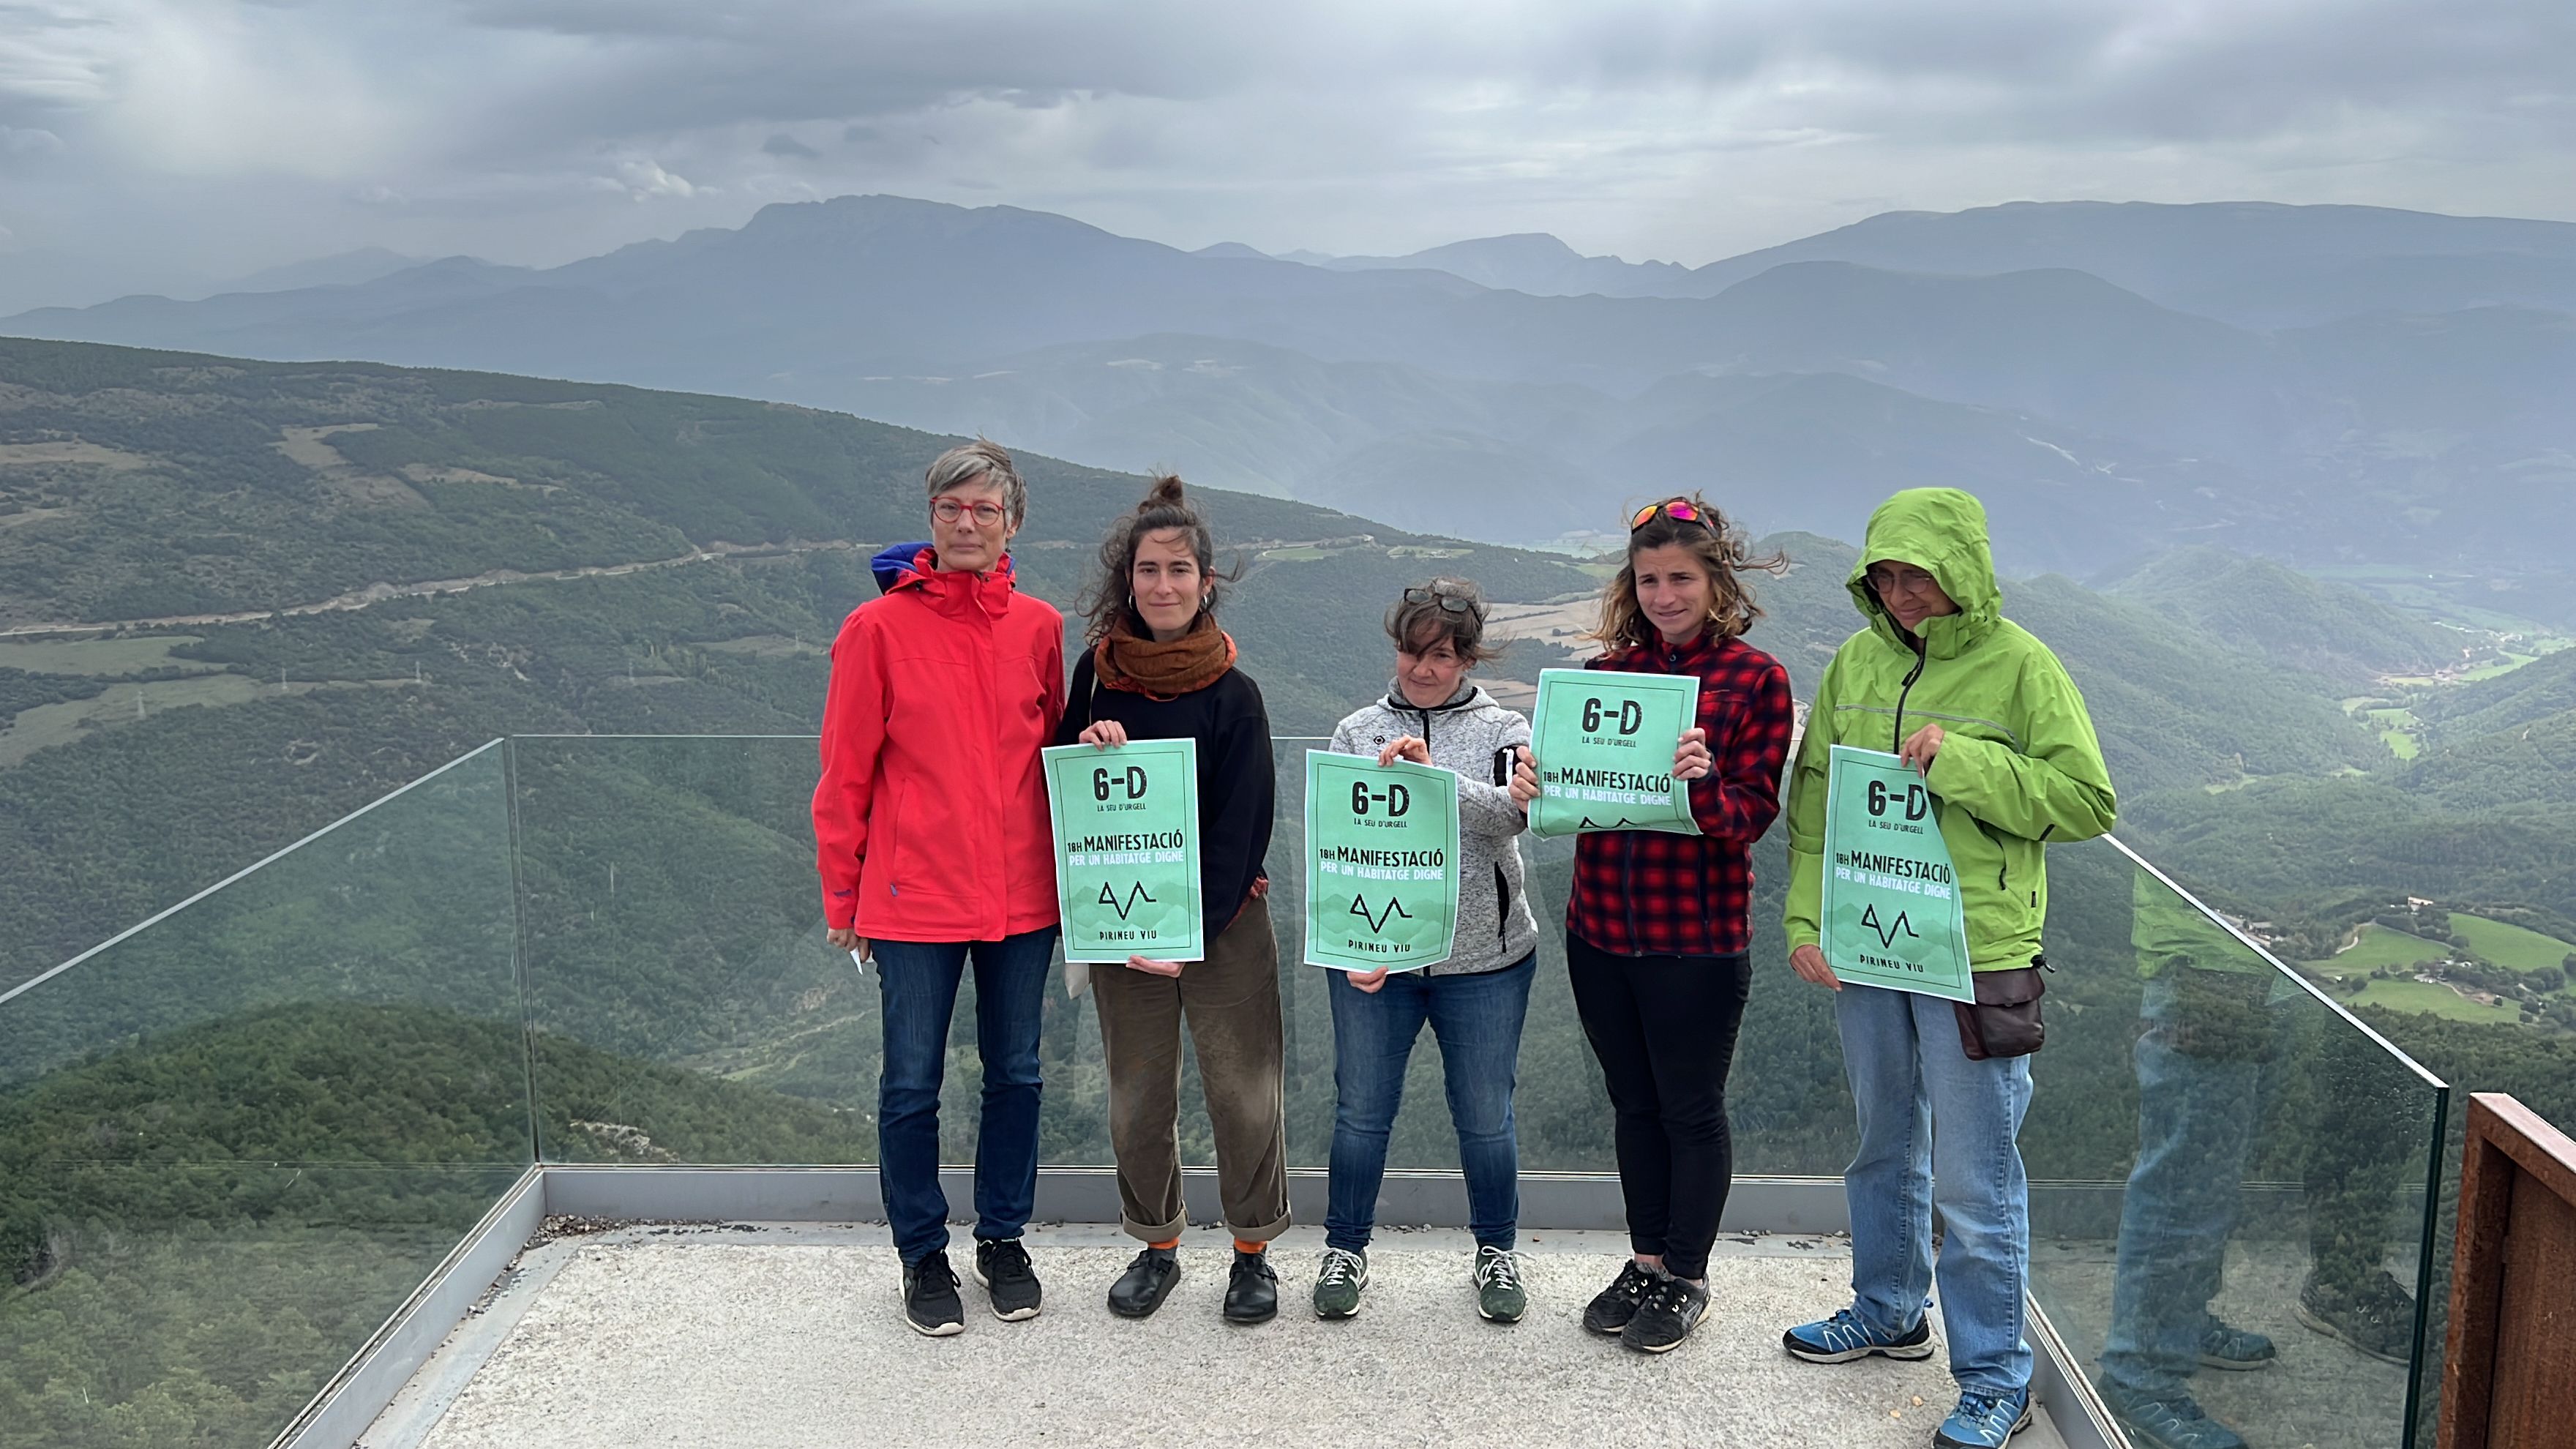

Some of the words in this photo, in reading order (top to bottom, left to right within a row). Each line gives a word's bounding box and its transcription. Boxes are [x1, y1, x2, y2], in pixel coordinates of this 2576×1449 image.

[1582, 698, 1642, 735] 6-D
[1608, 738, 1636, 748] D'URGELL
[1093, 766, 1147, 801] 6-D
[1543, 771, 1558, 783] 18H
[1562, 768, 1670, 793] MANIFESTACIÓ
[1352, 782, 1409, 817] 6-D
[1544, 785, 1560, 797] PER
[1565, 787, 1579, 799] UN
[1583, 789, 1636, 804] HABITATGE
[1640, 794, 1671, 805] DIGNE
[1868, 780, 1926, 820] 6-D
[1119, 803, 1146, 811] D'URGELL
[1354, 817, 1361, 825] LA
[1880, 821, 1891, 830] SEU
[1894, 823, 1923, 834] D'URGELL
[1068, 842, 1082, 853] 18H
[1085, 829, 1183, 852] MANIFESTACIÓ
[1069, 855, 1085, 866] PER
[1089, 854, 1101, 865] UN
[1104, 852, 1151, 865] HABITATGE
[1156, 851, 1184, 862] DIGNE
[1320, 849, 1335, 859] 18H
[1338, 846, 1443, 866] MANIFESTACIÓ
[1321, 861, 1337, 873] PER
[1341, 865, 1354, 875] UN
[1358, 868, 1409, 880] HABITATGE
[1414, 869, 1443, 880] DIGNE
[1836, 853, 1849, 866] 18H
[1852, 850, 1950, 884] MANIFESTACIÓ
[1836, 867, 1850, 880] PER
[1854, 871, 1865, 884] UN
[1869, 875, 1920, 894] HABITATGE
[1925, 885, 1951, 900] DIGNE
[1099, 931, 1134, 940] PIRINEU
[1140, 931, 1156, 940] VIU
[1349, 940, 1387, 952] PIRINEU
[1394, 944, 1410, 952] VIU
[1860, 954, 1900, 969] PIRINEU
[1906, 962, 1923, 973] VIU
